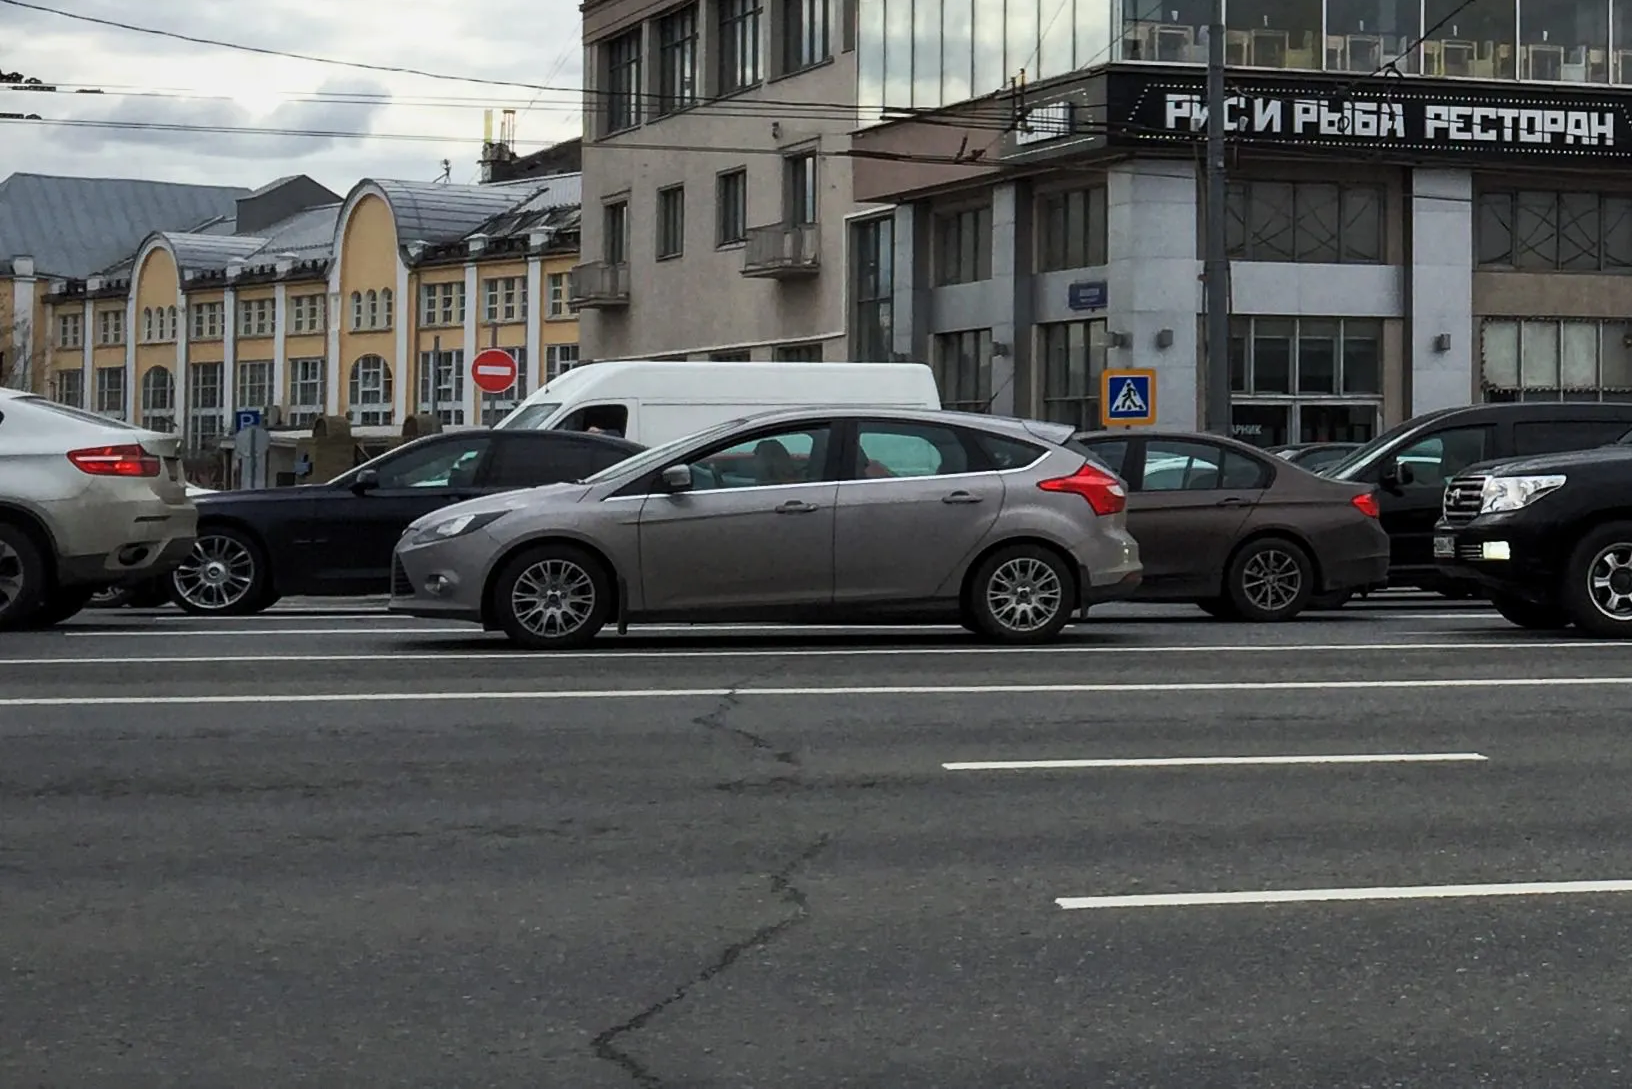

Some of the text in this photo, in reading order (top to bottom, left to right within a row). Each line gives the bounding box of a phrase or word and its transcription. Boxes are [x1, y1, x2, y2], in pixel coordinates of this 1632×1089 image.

[1254, 97, 1282, 132] И
[1293, 98, 1405, 138] РЫБА
[1424, 105, 1615, 145] РЕСТОРАН
